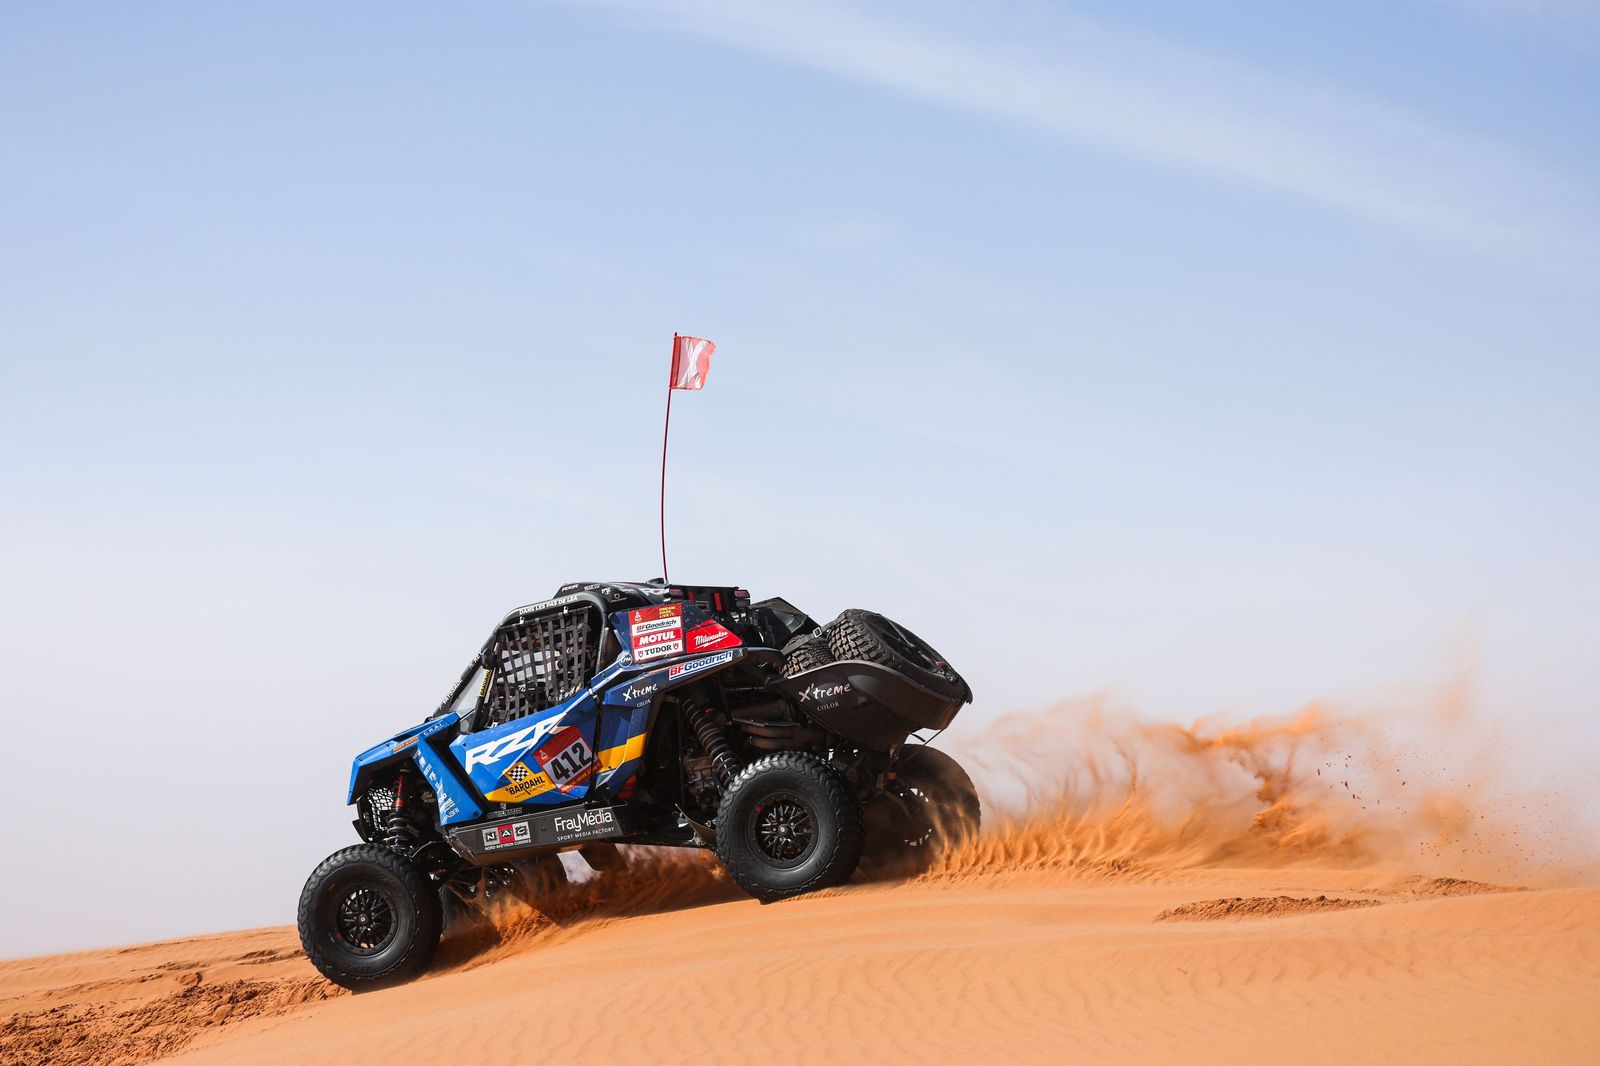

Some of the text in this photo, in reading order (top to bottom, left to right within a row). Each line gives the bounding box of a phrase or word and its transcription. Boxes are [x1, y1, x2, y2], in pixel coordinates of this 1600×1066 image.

[519, 606, 535, 615] DANS
[546, 600, 557, 608] PAS
[636, 619, 677, 631] BFGoodrich
[640, 631, 676, 645] MOTUL
[645, 644, 672, 655] TUDOR
[669, 651, 733, 677] BFGoodrich
[799, 682, 851, 703] X'treme
[816, 701, 840, 712] COLOR
[551, 742, 593, 781] 412
[508, 775, 546, 796] BARDAHL
[554, 809, 614, 833] FrayMédia
[557, 834, 574, 842] SPORT
[592, 826, 615, 836] FACTORY
